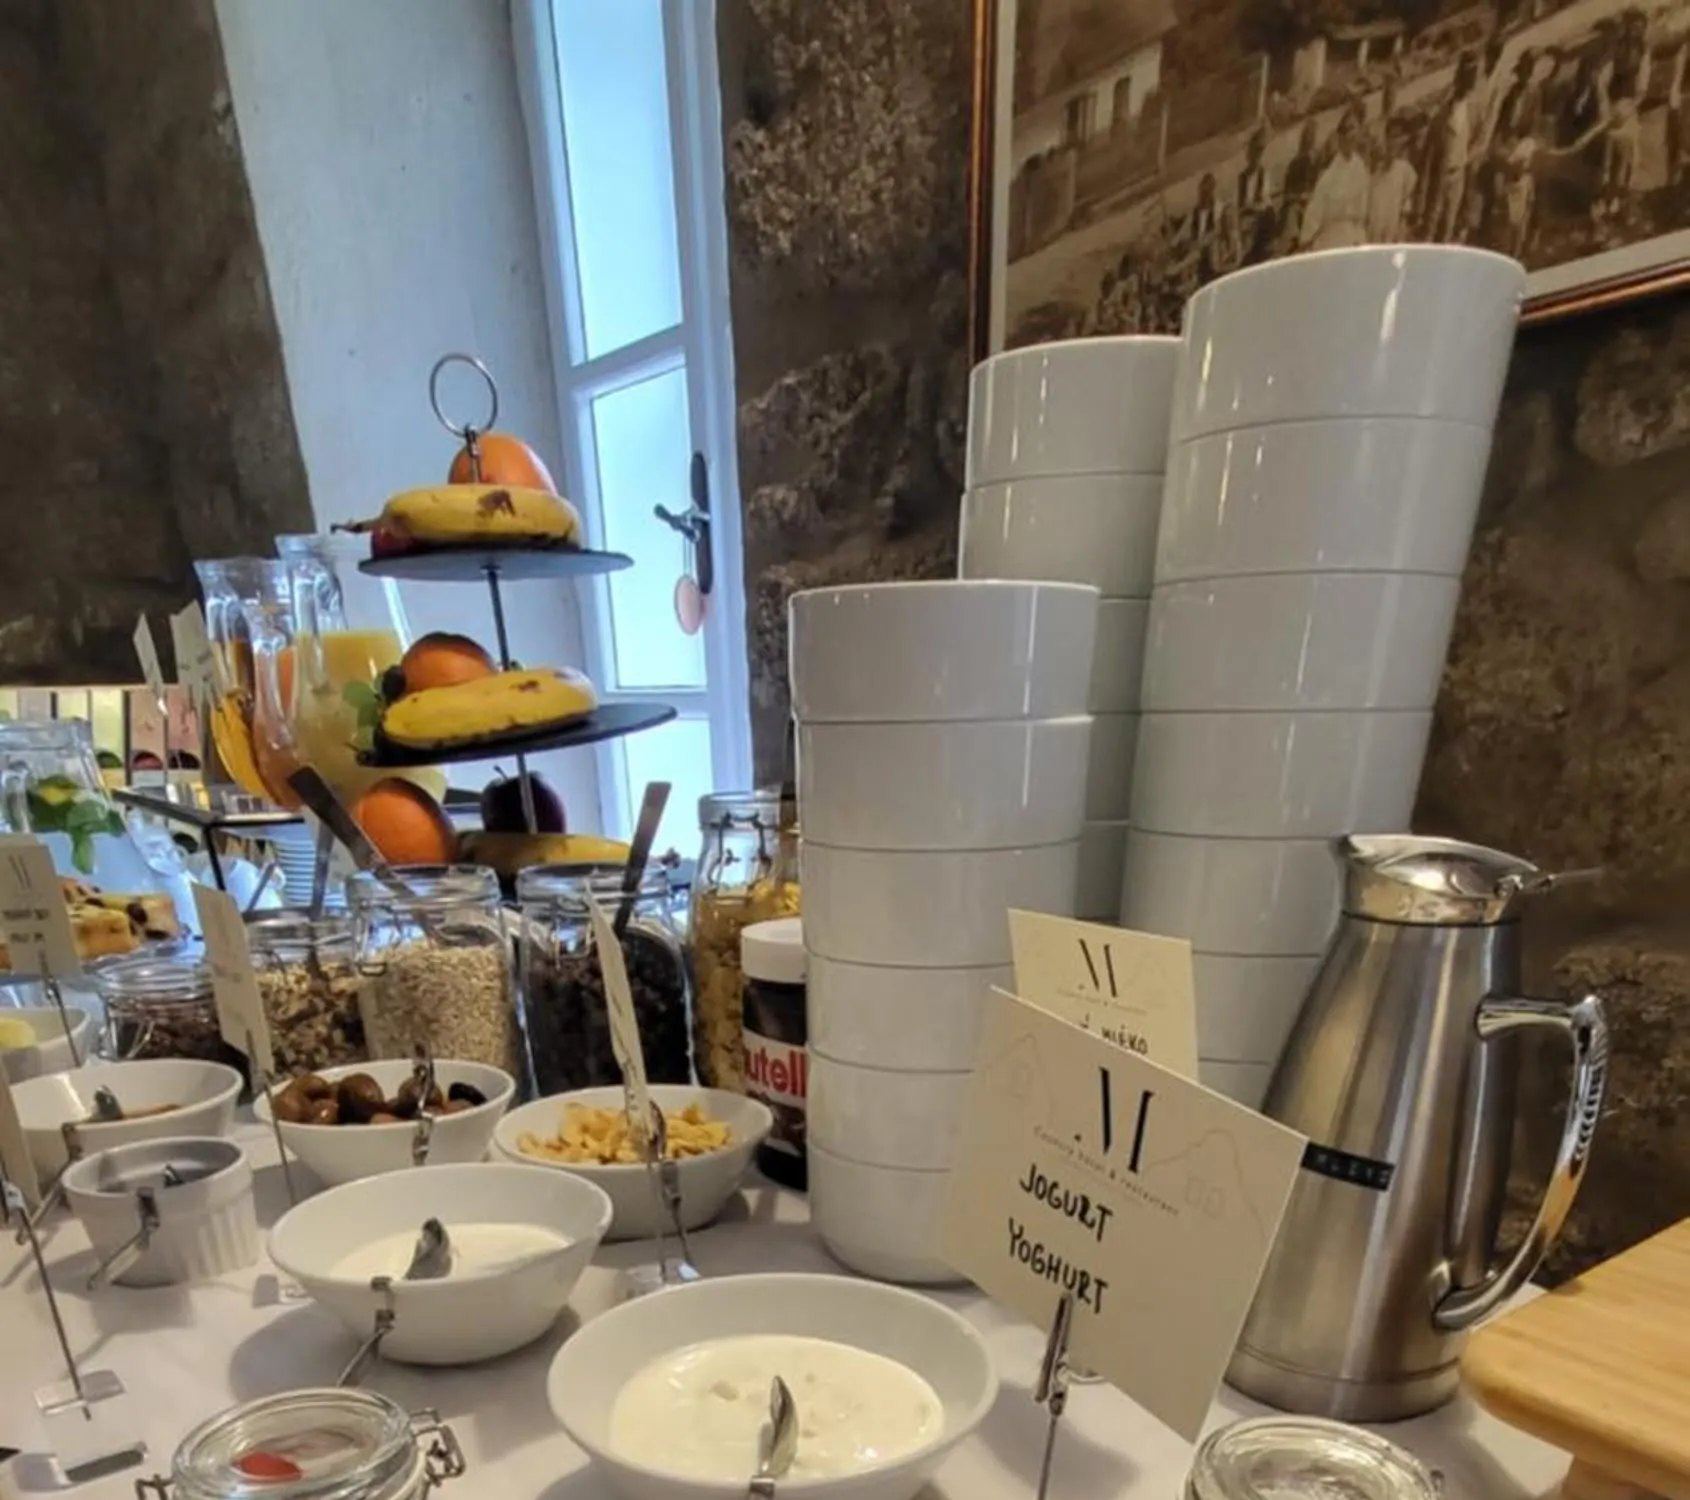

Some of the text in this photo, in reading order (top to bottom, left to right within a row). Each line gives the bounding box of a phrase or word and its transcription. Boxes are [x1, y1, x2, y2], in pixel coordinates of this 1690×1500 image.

[743, 1047, 807, 1098] utell
[1019, 1162, 1114, 1242] JOGURT
[1008, 1216, 1109, 1315] YOGHURT
